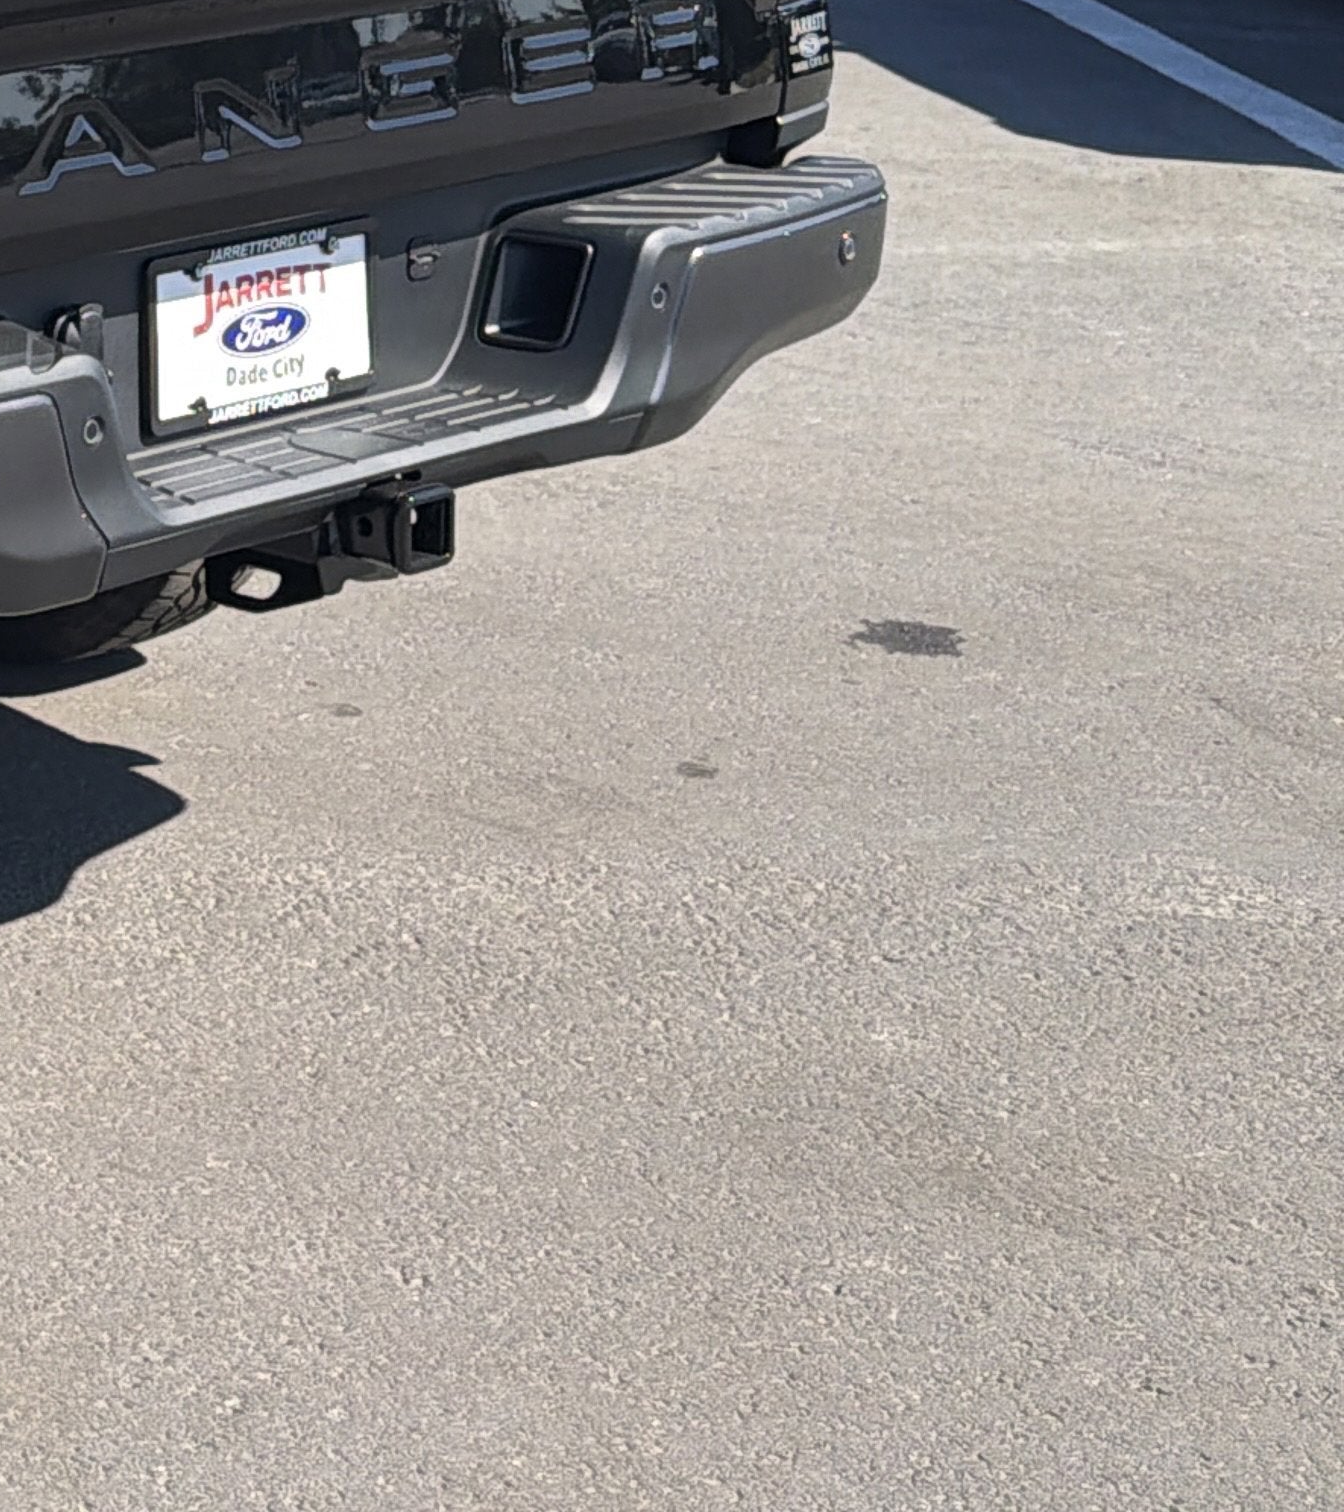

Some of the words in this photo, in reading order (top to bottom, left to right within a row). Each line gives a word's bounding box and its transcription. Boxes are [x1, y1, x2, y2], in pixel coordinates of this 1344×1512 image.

[207, 226, 329, 265] JARRETTFORD.COM
[192, 261, 333, 338] JARRETT
[234, 309, 292, 352] Ford
[225, 362, 269, 387] Dade
[272, 353, 306, 379] City
[208, 381, 330, 425] JARRETTFORD.COM
